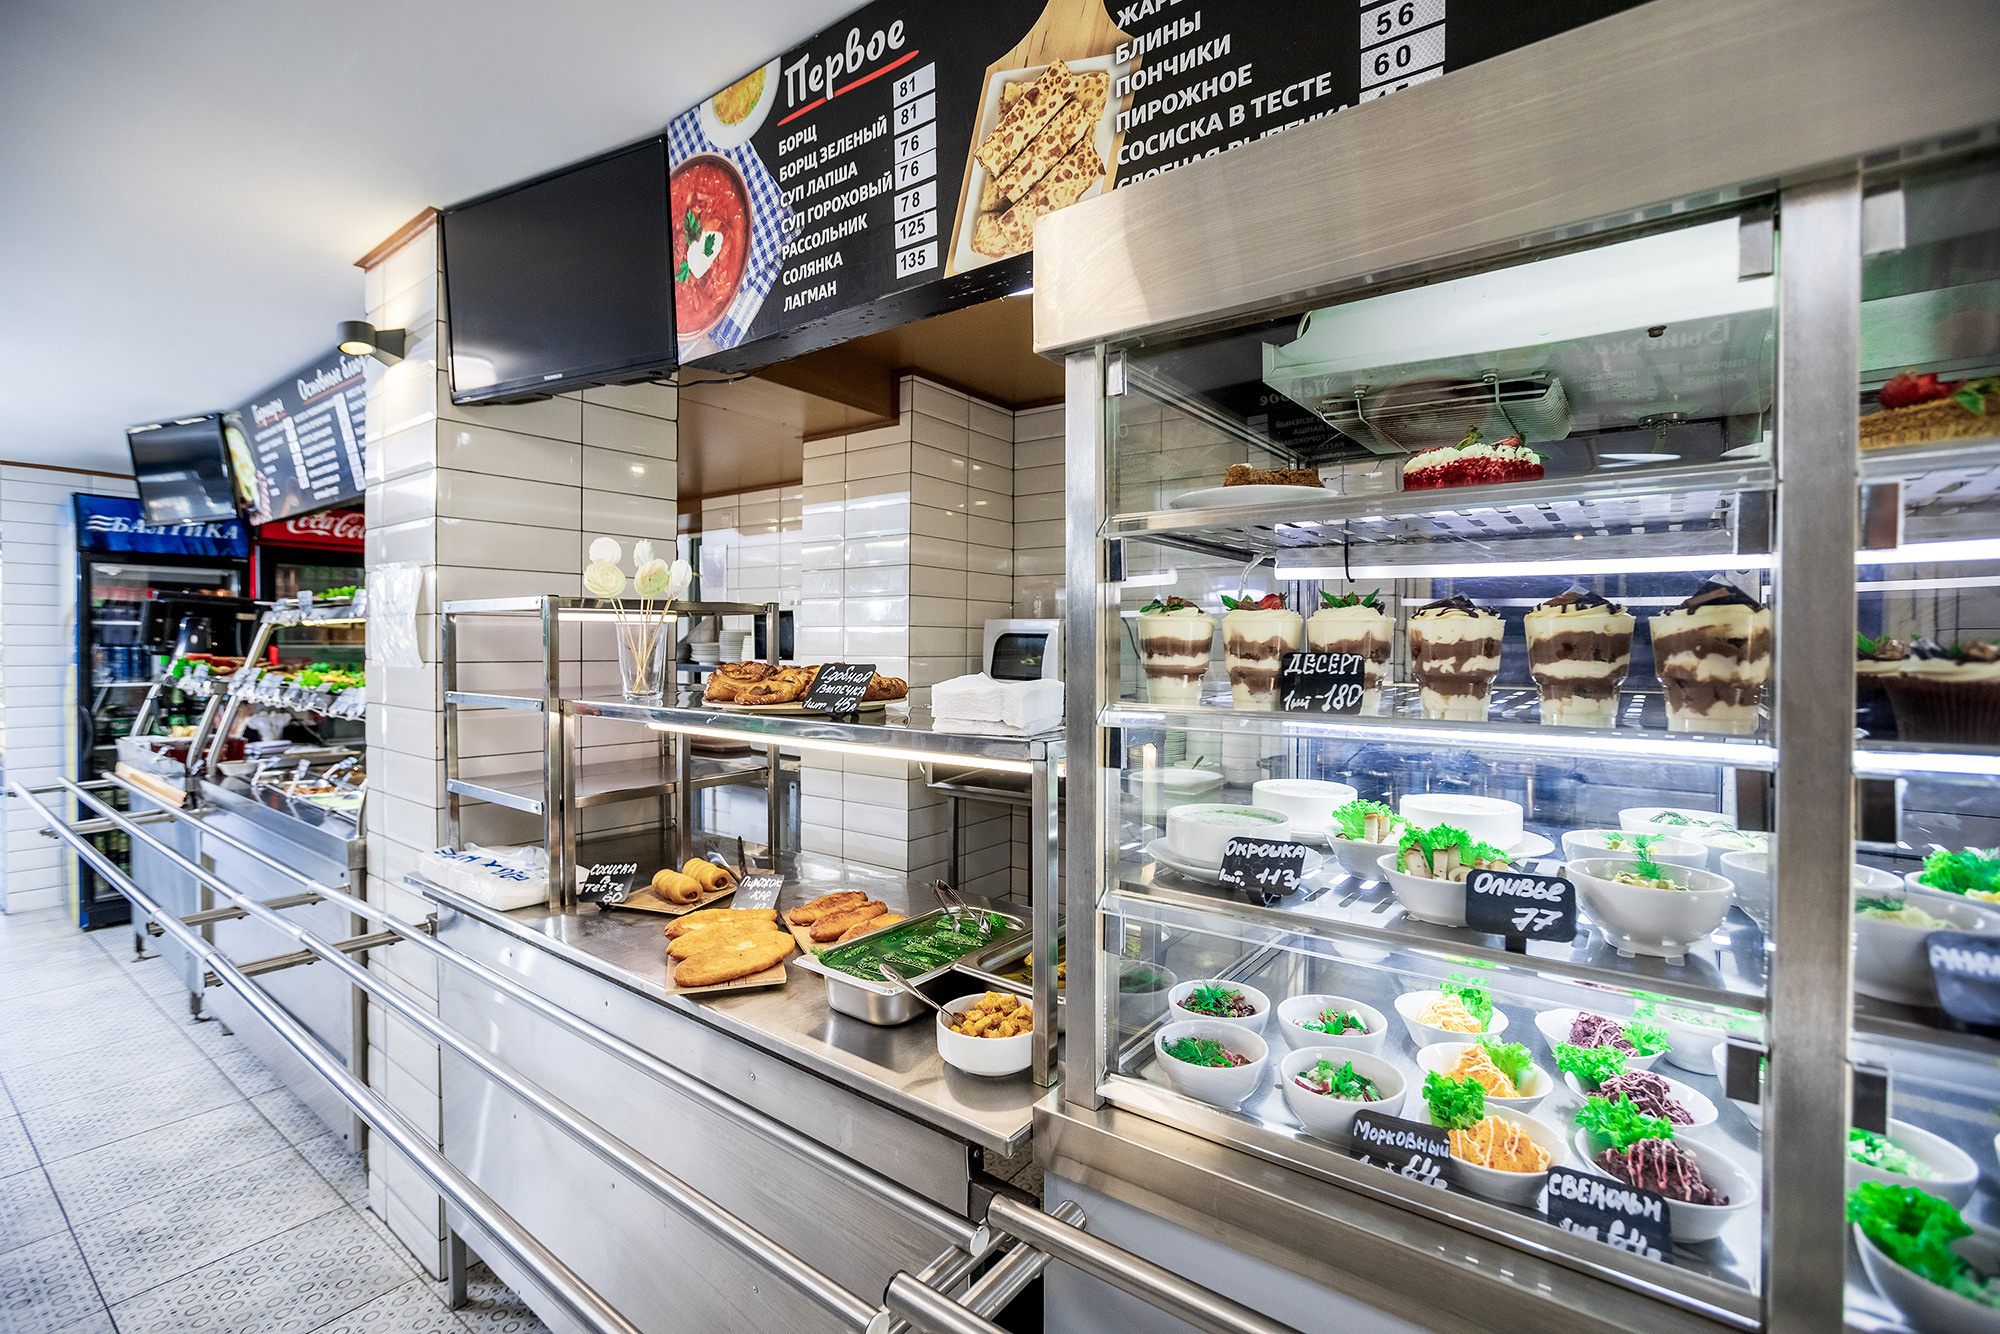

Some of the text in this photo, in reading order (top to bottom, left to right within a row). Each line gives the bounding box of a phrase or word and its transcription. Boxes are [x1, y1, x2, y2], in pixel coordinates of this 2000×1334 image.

[1117, 0, 1182, 29] ЖАР
[1376, 2, 1414, 36] 56
[1116, 10, 1201, 65] БЛИНЫ
[784, 19, 906, 108] Первое
[1116, 33, 1231, 98] ПОНЧИКИ
[1374, 45, 1411, 76] 60
[899, 75, 916, 98] 81
[1116, 63, 1253, 133] ПИРОЖНОЕ
[901, 103, 917, 125] 81
[1116, 112, 1224, 166] СОСИСКА
[1229, 104, 1246, 127] В
[1250, 71, 1332, 119] ТЕСТЕ
[778, 124, 818, 157] БОРЩ
[779, 114, 888, 183] БОРЩ ЗЕЛЕНЫЙ
[900, 134, 919, 157] 76
[780, 161, 859, 208] СУП ЛАПША
[900, 160, 919, 182] 76
[780, 170, 893, 234] СУП ГОРОХОВЫЙ
[901, 191, 920, 213] 78
[782, 212, 869, 261] РАССОЛЬНИК
[900, 217, 926, 239] 125
[782, 251, 844, 286] СОЛЯНКА
[900, 249, 926, 271] 135
[783, 280, 837, 312] ЛАГМАН
[1284, 653, 1363, 676] ДЕСЕРТ
[590, 862, 638, 876] СОСИСКА
[1473, 872, 1567, 902] Оливье
[1510, 907, 1564, 932] 77
